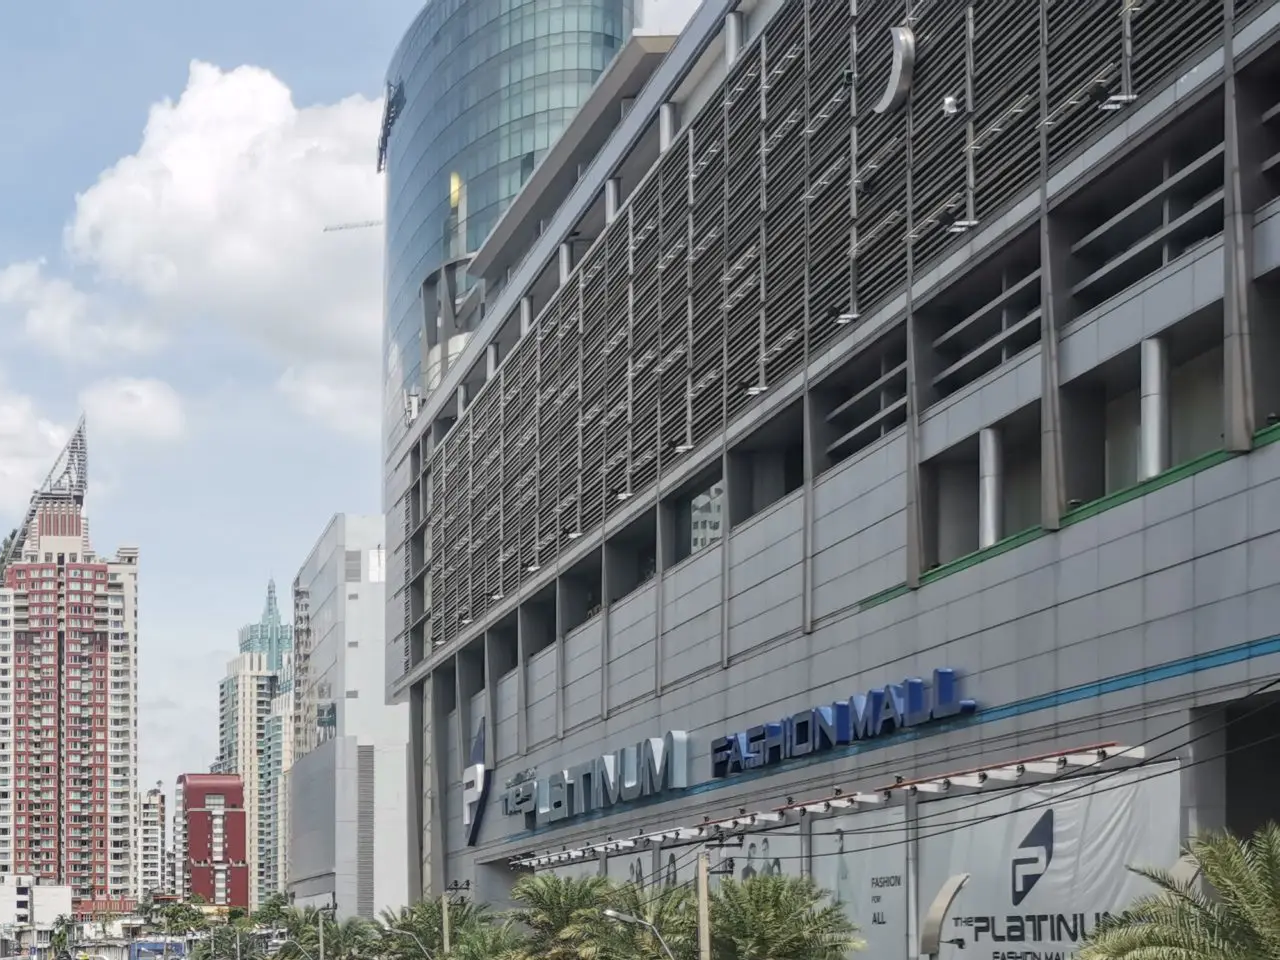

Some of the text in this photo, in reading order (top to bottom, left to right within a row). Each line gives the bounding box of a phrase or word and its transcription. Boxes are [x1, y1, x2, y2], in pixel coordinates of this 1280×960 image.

[711, 668, 978, 779] FASHION MALL
[520, 730, 688, 832] PLATINUM
[871, 875, 901, 888] FASHION
[871, 911, 887, 925] ALL
[952, 911, 1132, 942] THE PLATINU
